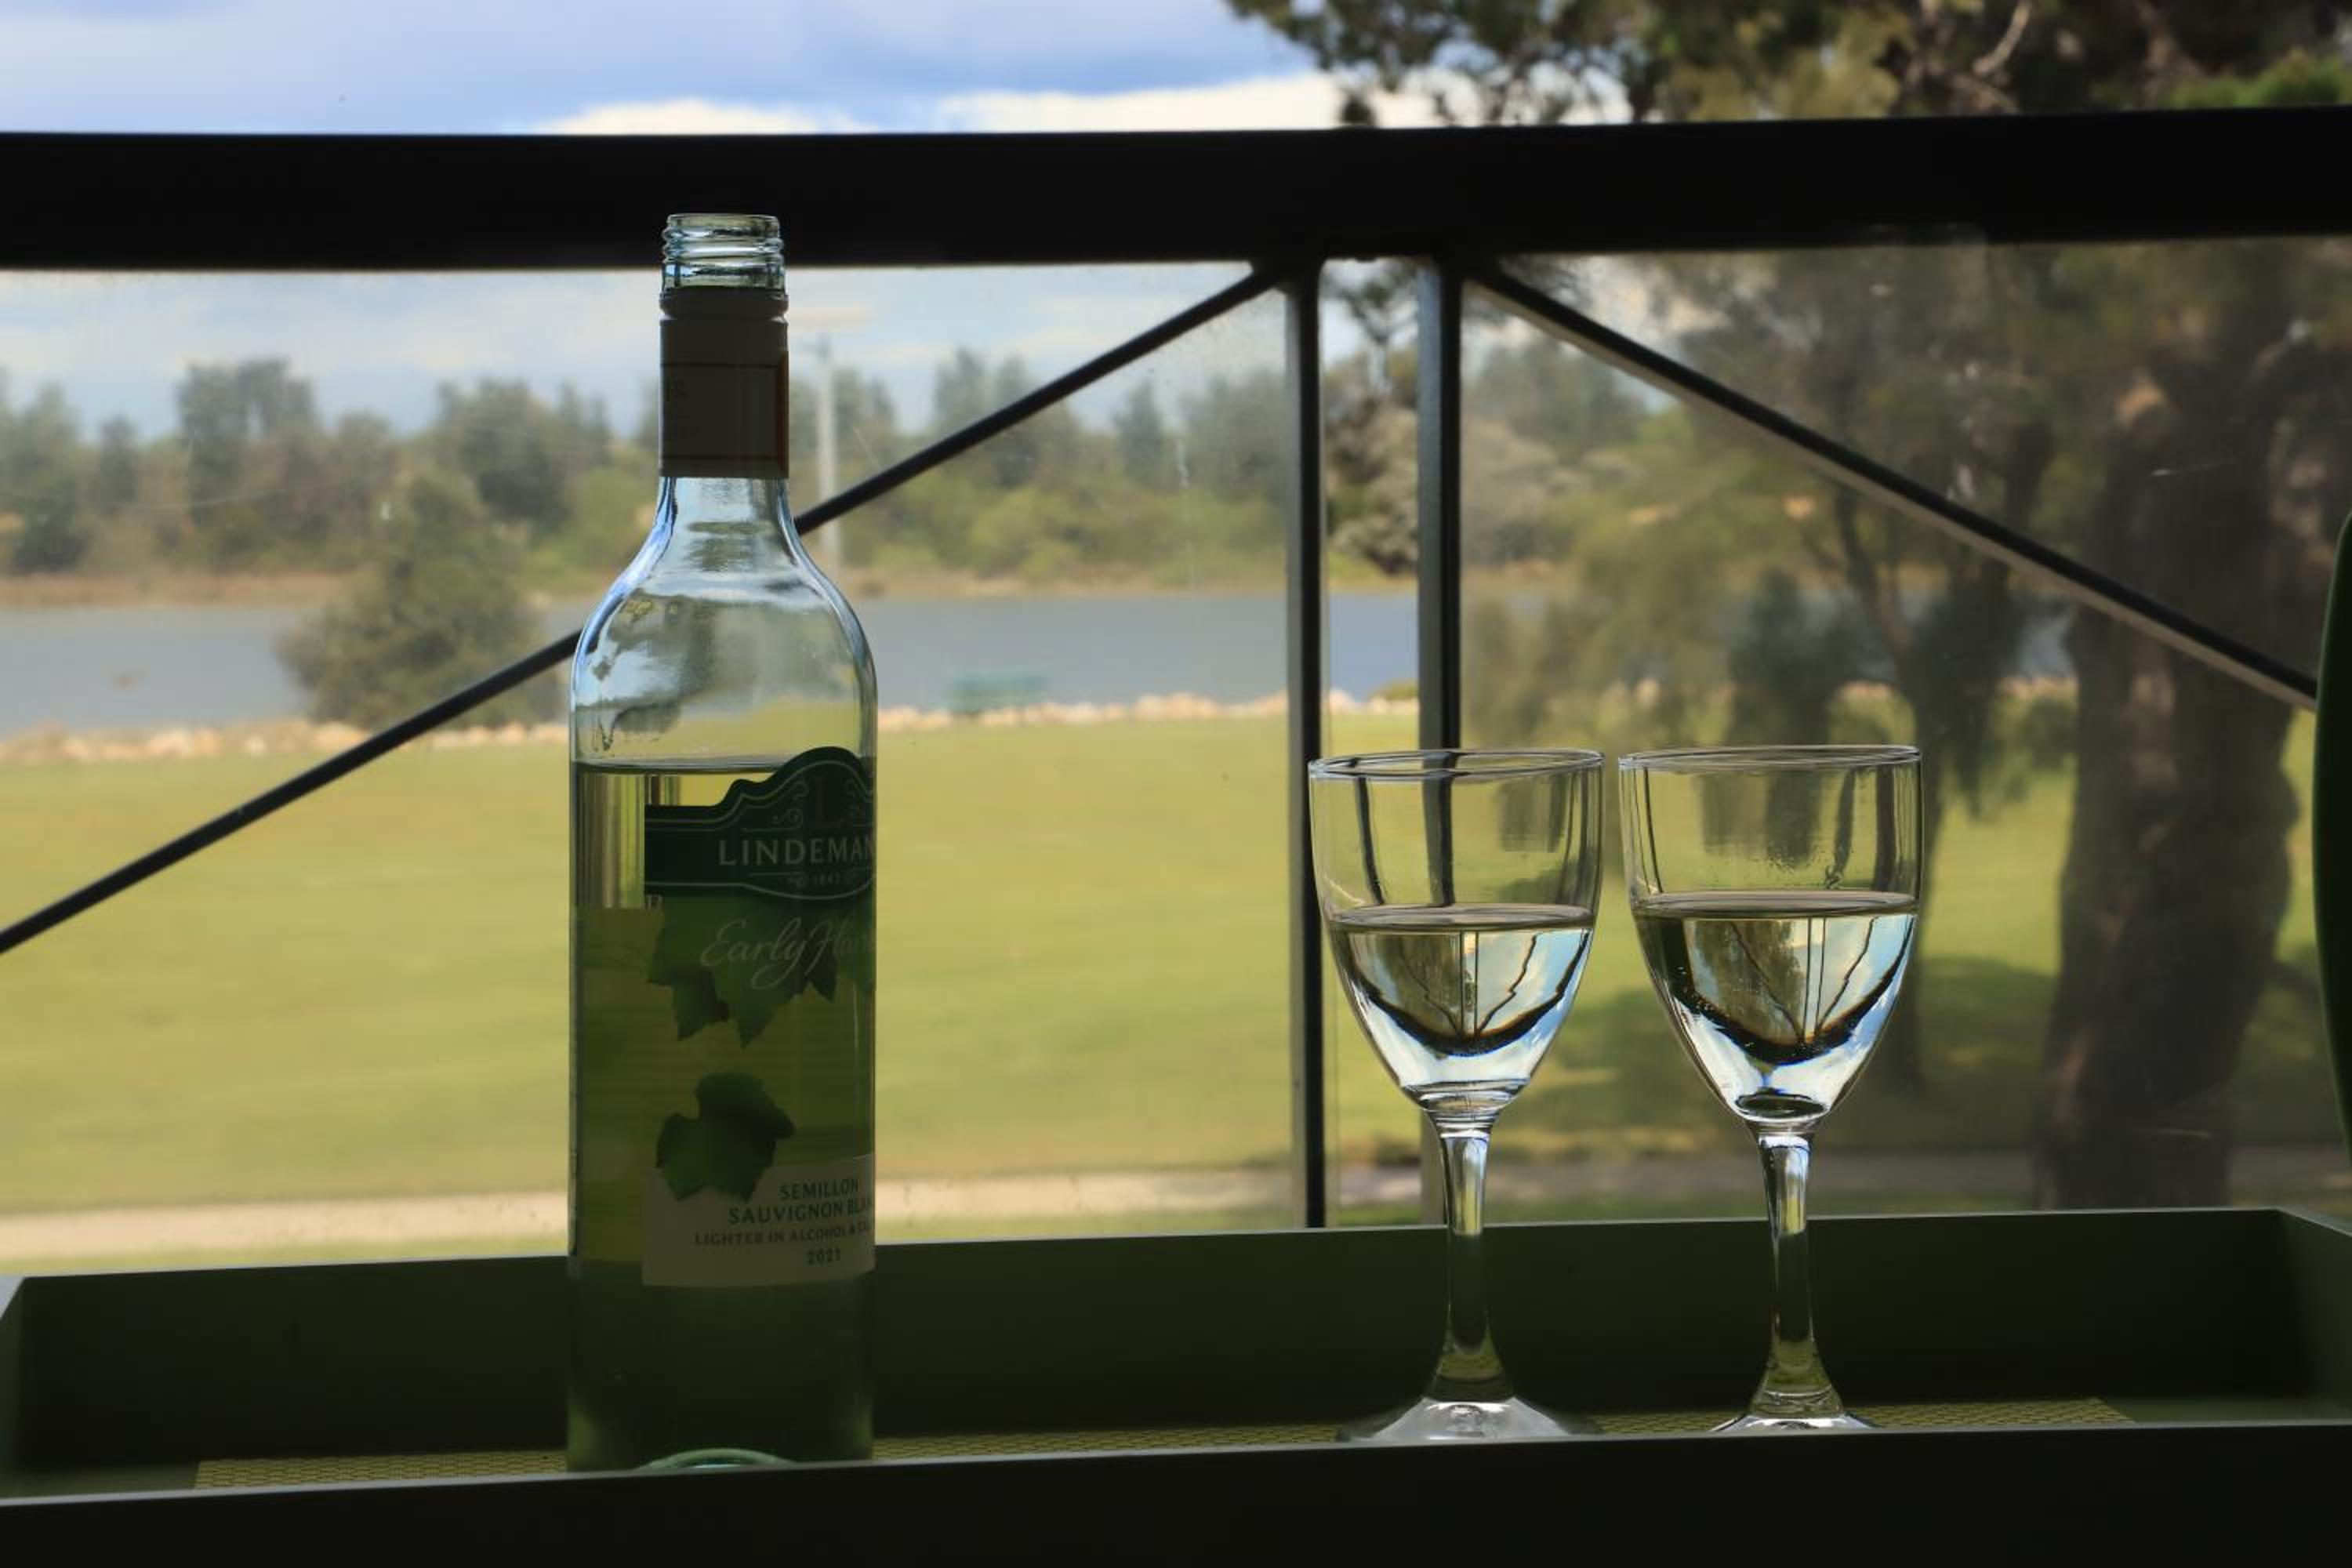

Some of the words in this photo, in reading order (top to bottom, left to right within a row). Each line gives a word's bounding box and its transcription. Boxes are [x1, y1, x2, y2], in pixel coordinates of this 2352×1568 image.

[700, 917, 808, 990] Early
[779, 1178, 860, 1201] SEMILLON
[728, 1201, 843, 1225] SAUVIGNON
[768, 1231, 785, 1243] IN
[806, 1247, 842, 1266] 2021
